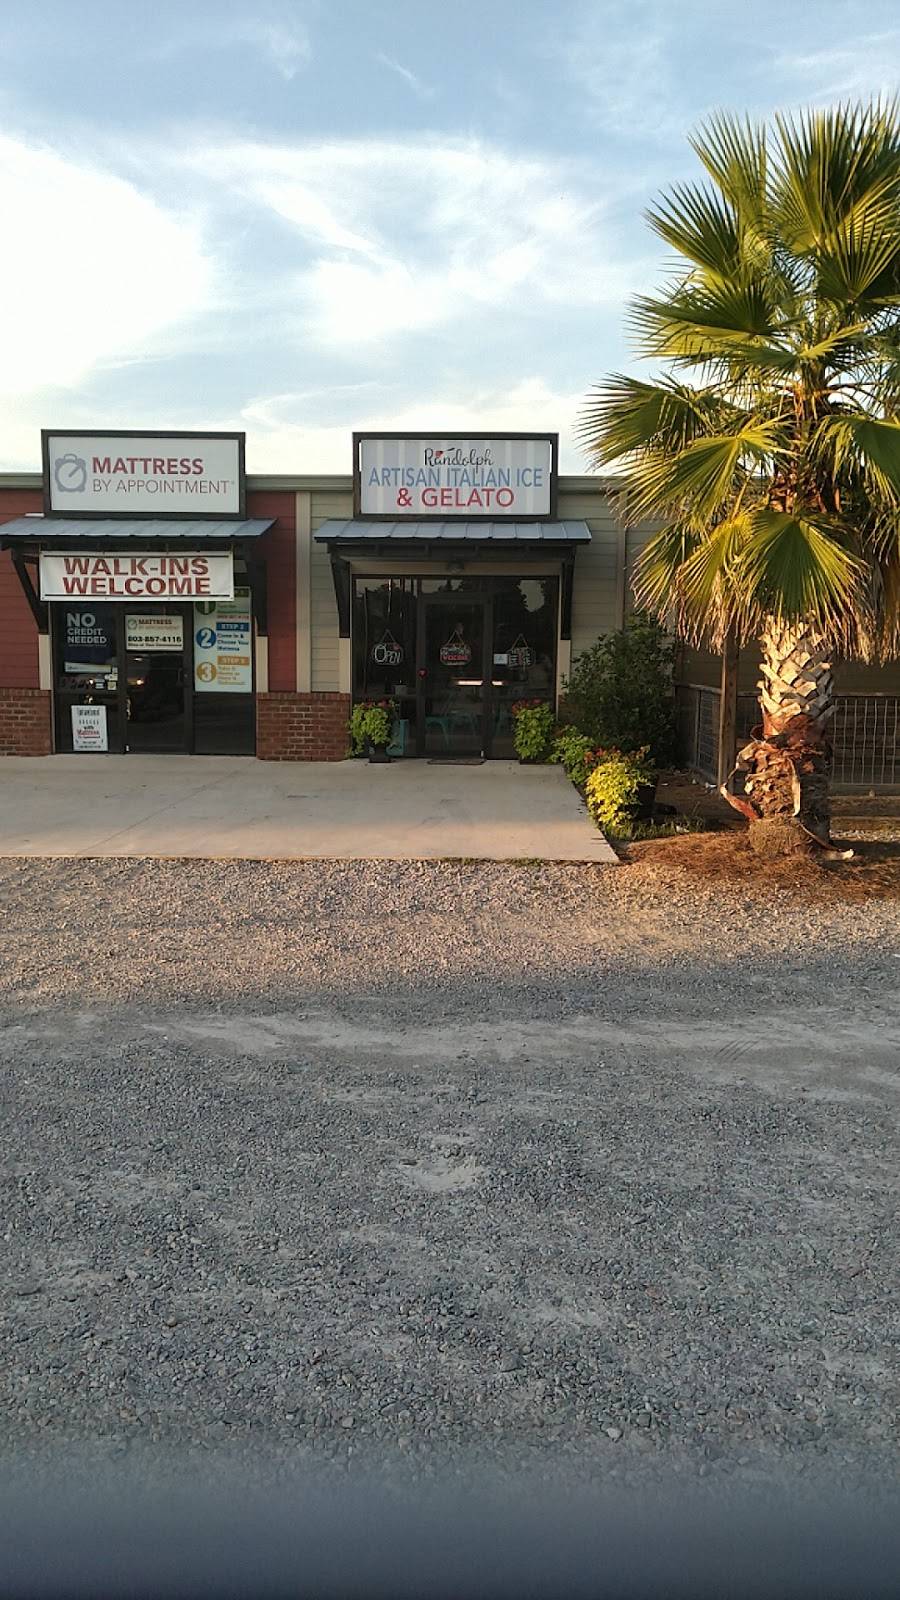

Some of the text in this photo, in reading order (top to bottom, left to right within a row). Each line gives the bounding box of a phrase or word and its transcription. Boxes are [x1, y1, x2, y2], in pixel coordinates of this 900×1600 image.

[92, 457, 204, 475] MATTRESS
[424, 447, 494, 473] Randolph
[93, 479, 231, 494] BY APPOINTMENT
[368, 467, 543, 488] ARTISAN ITALIAN ICE
[397, 488, 515, 507] & GELATO
[63, 557, 209, 576] WALK-INS
[62, 577, 212, 595] WELCOME
[66, 612, 96, 628] NO
[67, 628, 104, 636] CREDIT
[67, 636, 107, 644] NEEDED
[200, 629, 213, 647] 2
[201, 663, 212, 681] 3
